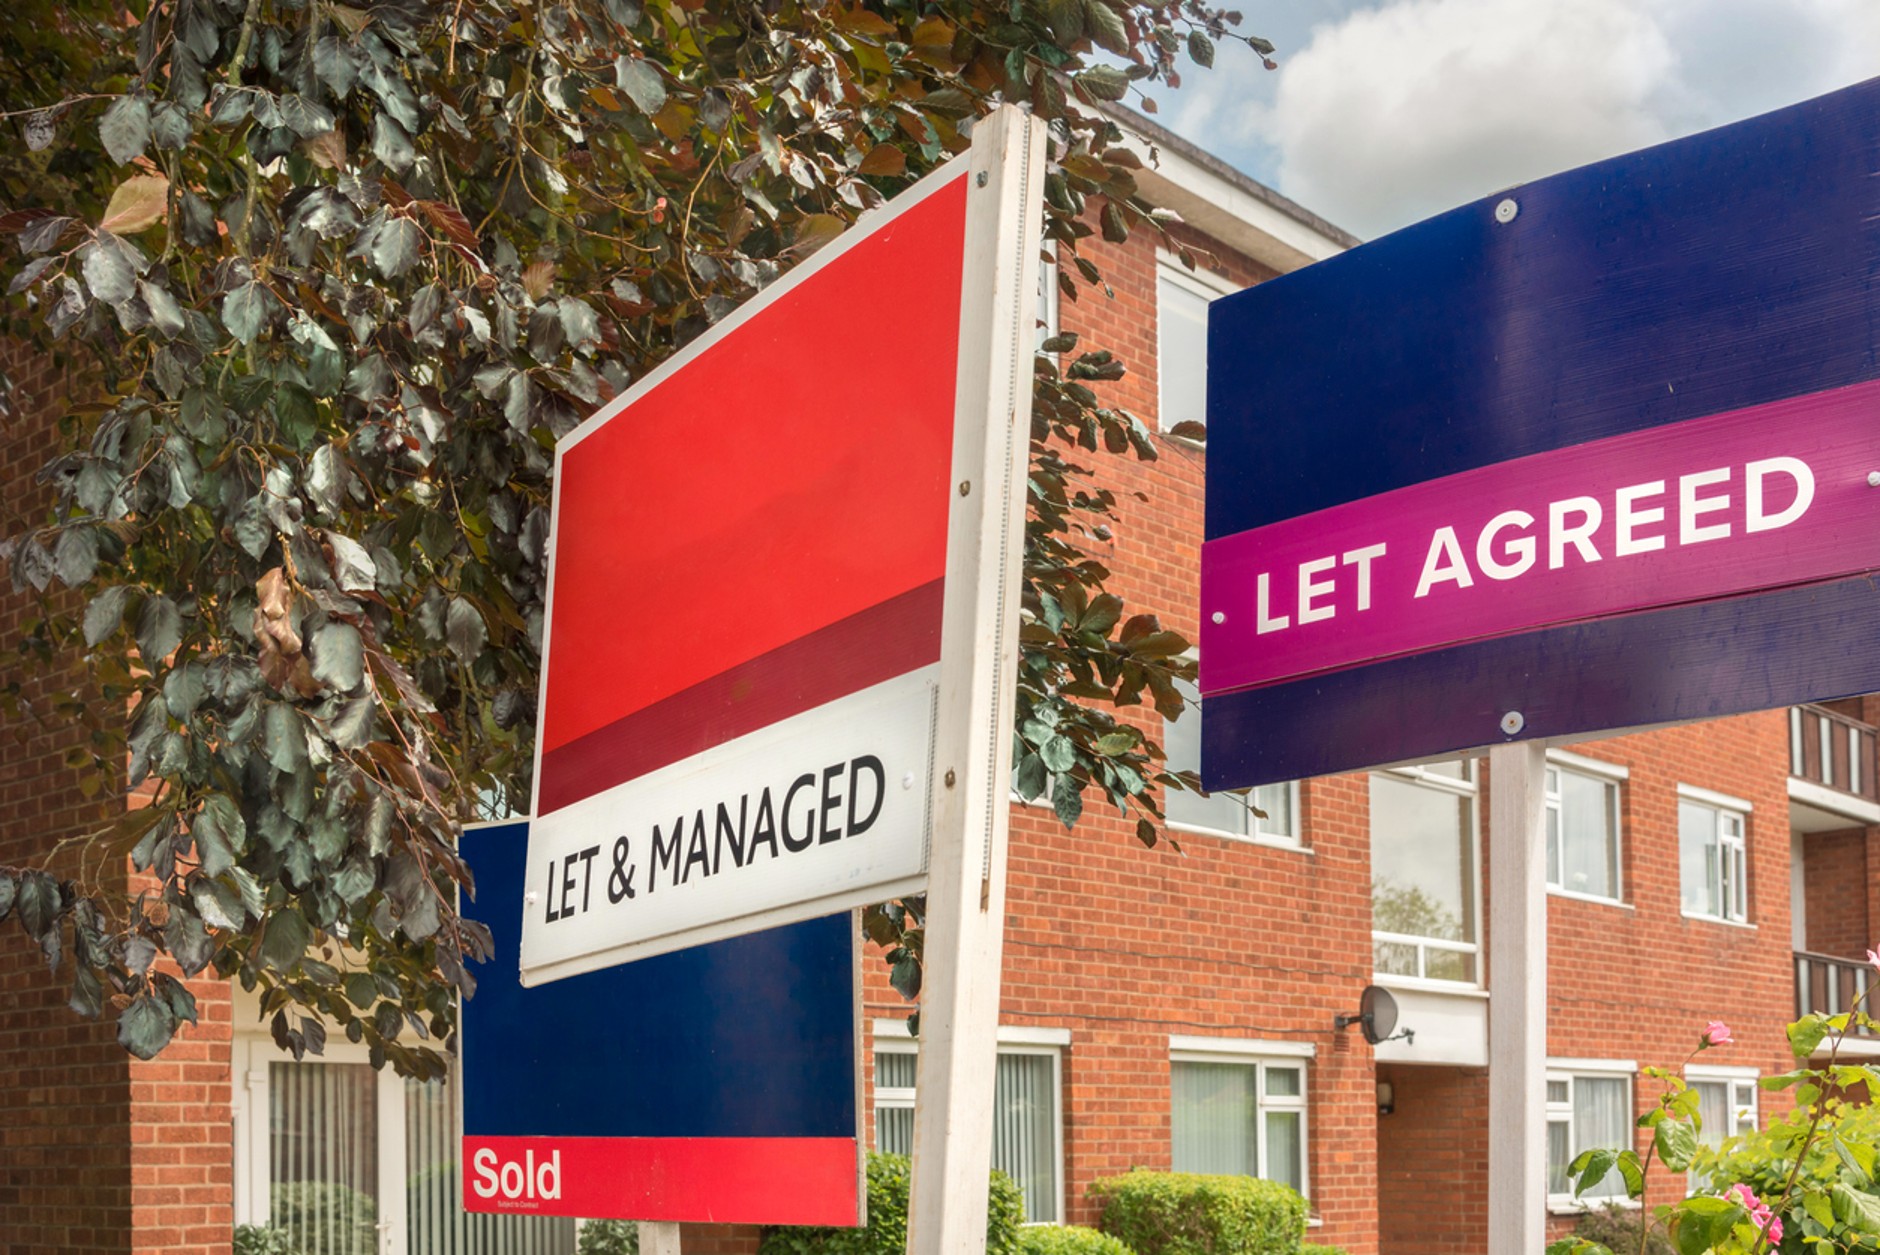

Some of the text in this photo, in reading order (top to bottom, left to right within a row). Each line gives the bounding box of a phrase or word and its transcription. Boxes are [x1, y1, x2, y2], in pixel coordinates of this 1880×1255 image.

[1256, 456, 1816, 635] LET AGREED
[546, 755, 885, 924] LET & MANAGED
[473, 1147, 561, 1200] Sold
